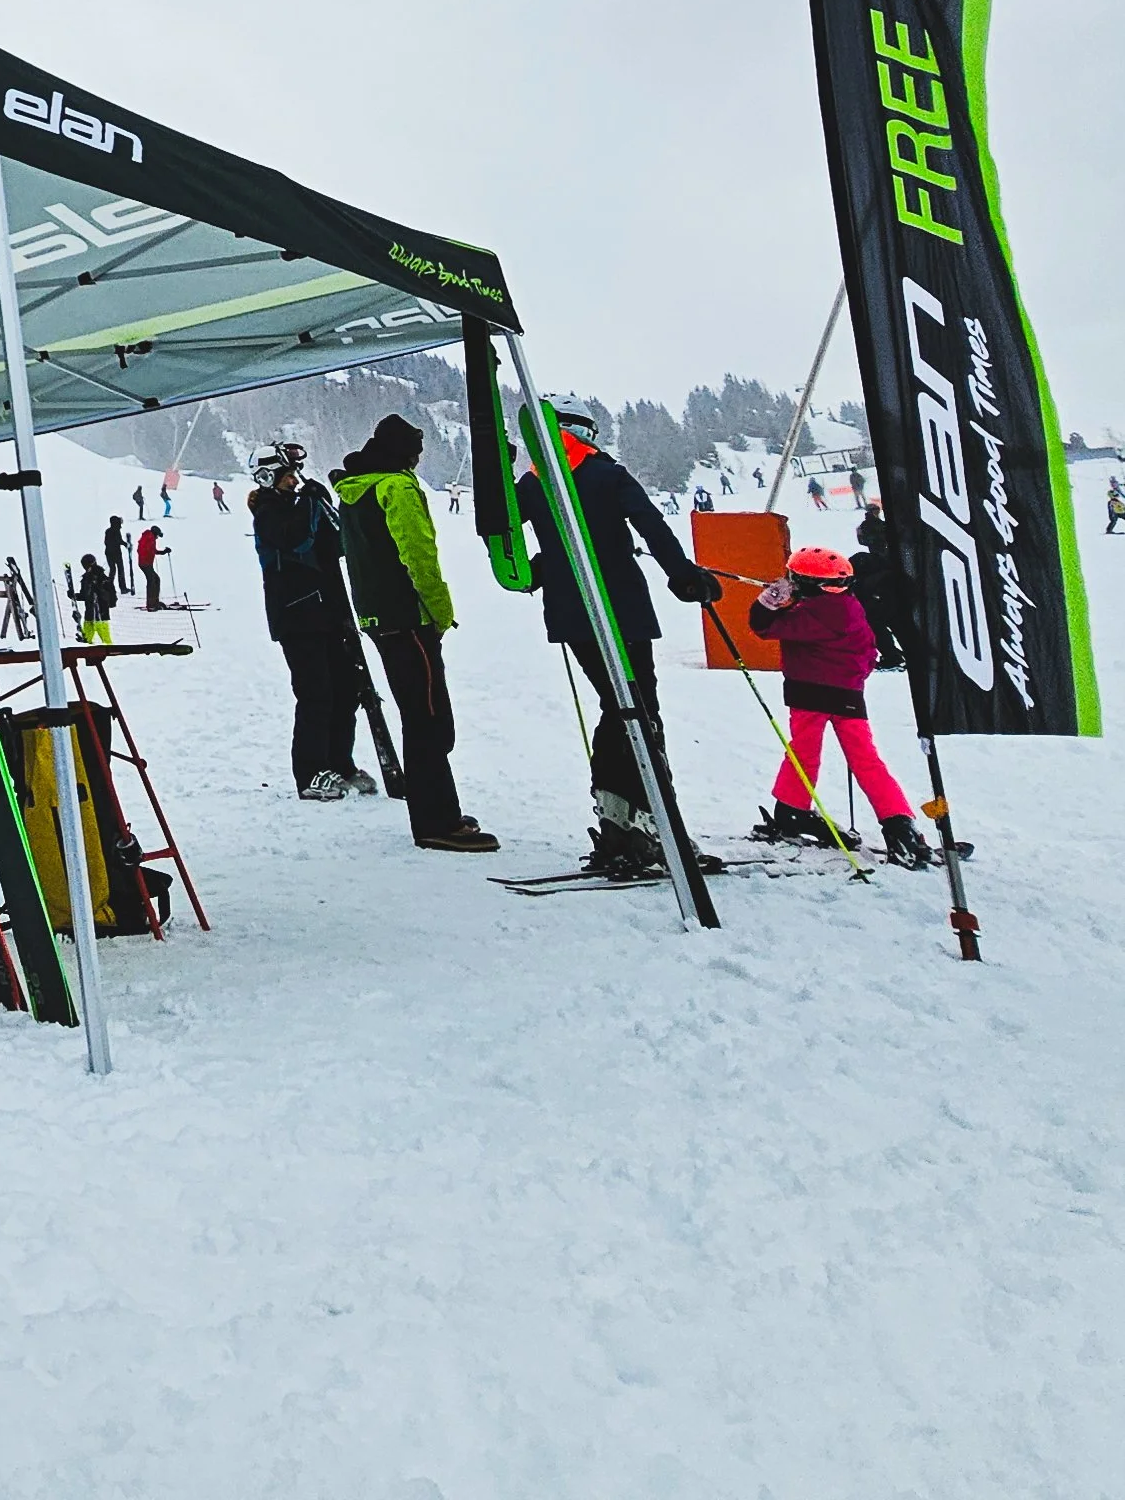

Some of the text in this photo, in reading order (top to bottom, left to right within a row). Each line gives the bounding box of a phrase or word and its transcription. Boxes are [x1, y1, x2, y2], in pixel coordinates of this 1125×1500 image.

[3, 88, 143, 164] elan
[870, 9, 964, 246] FREE
[902, 276, 994, 692] elan
[964, 316, 1037, 711] Always Good Times
